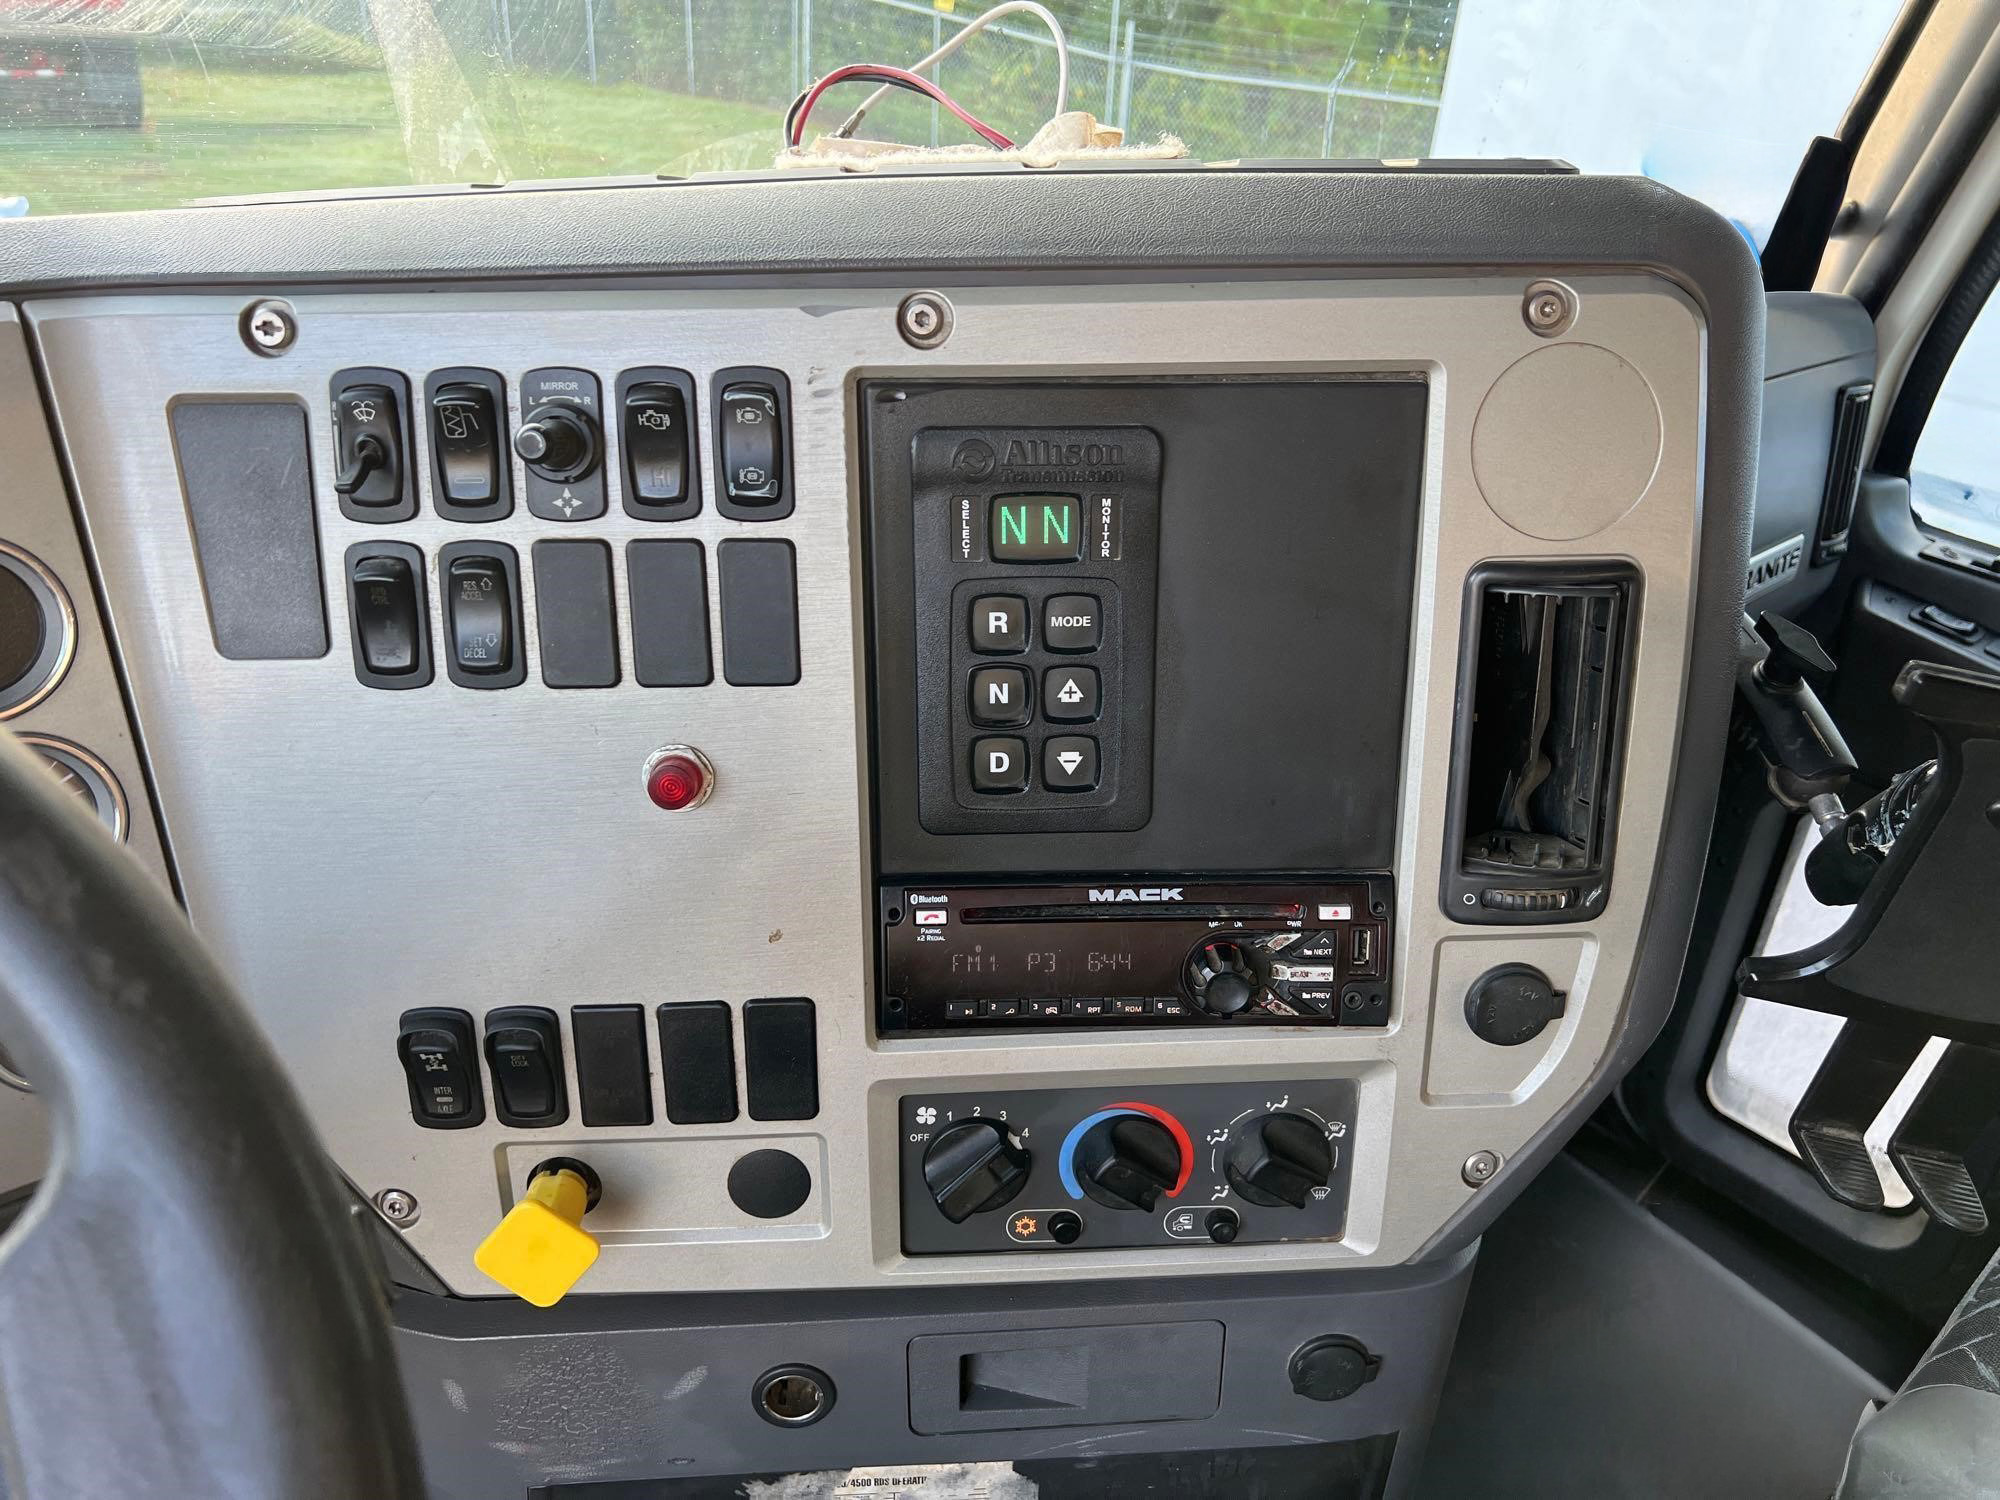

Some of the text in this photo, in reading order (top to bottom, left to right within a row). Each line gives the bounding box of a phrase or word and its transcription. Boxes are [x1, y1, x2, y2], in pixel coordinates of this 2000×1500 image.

[540, 381, 579, 391] MIRROR
[528, 396, 591, 405] L R
[1001, 439, 1126, 467] Allison
[1001, 469, 1125, 484] Transmission
[961, 499, 970, 559] SELECT
[1001, 505, 1069, 544] N N
[1101, 498, 1111, 558] MONITOR
[988, 611, 1008, 634] R
[1051, 616, 1091, 627] MODE
[463, 647, 487, 659] DECEL
[989, 683, 1009, 704] N
[989, 752, 1010, 773] D
[918, 895, 948, 903] Bluetooth
[1088, 888, 1184, 902] MACK
[1028, 952, 1056, 972] P3
[1088, 952, 1131, 972] 6:44
[1087, 1006, 1101, 1014] RPT
[1167, 1006, 1180, 1014] ESC
[433, 1086, 452, 1095] INTER
[946, 1111, 952, 1122] 1
[973, 1106, 981, 1117] 2
[999, 1110, 1007, 1121] 3
[909, 1133, 930, 1142] OFF
[1021, 1127, 1030, 1138] 4
